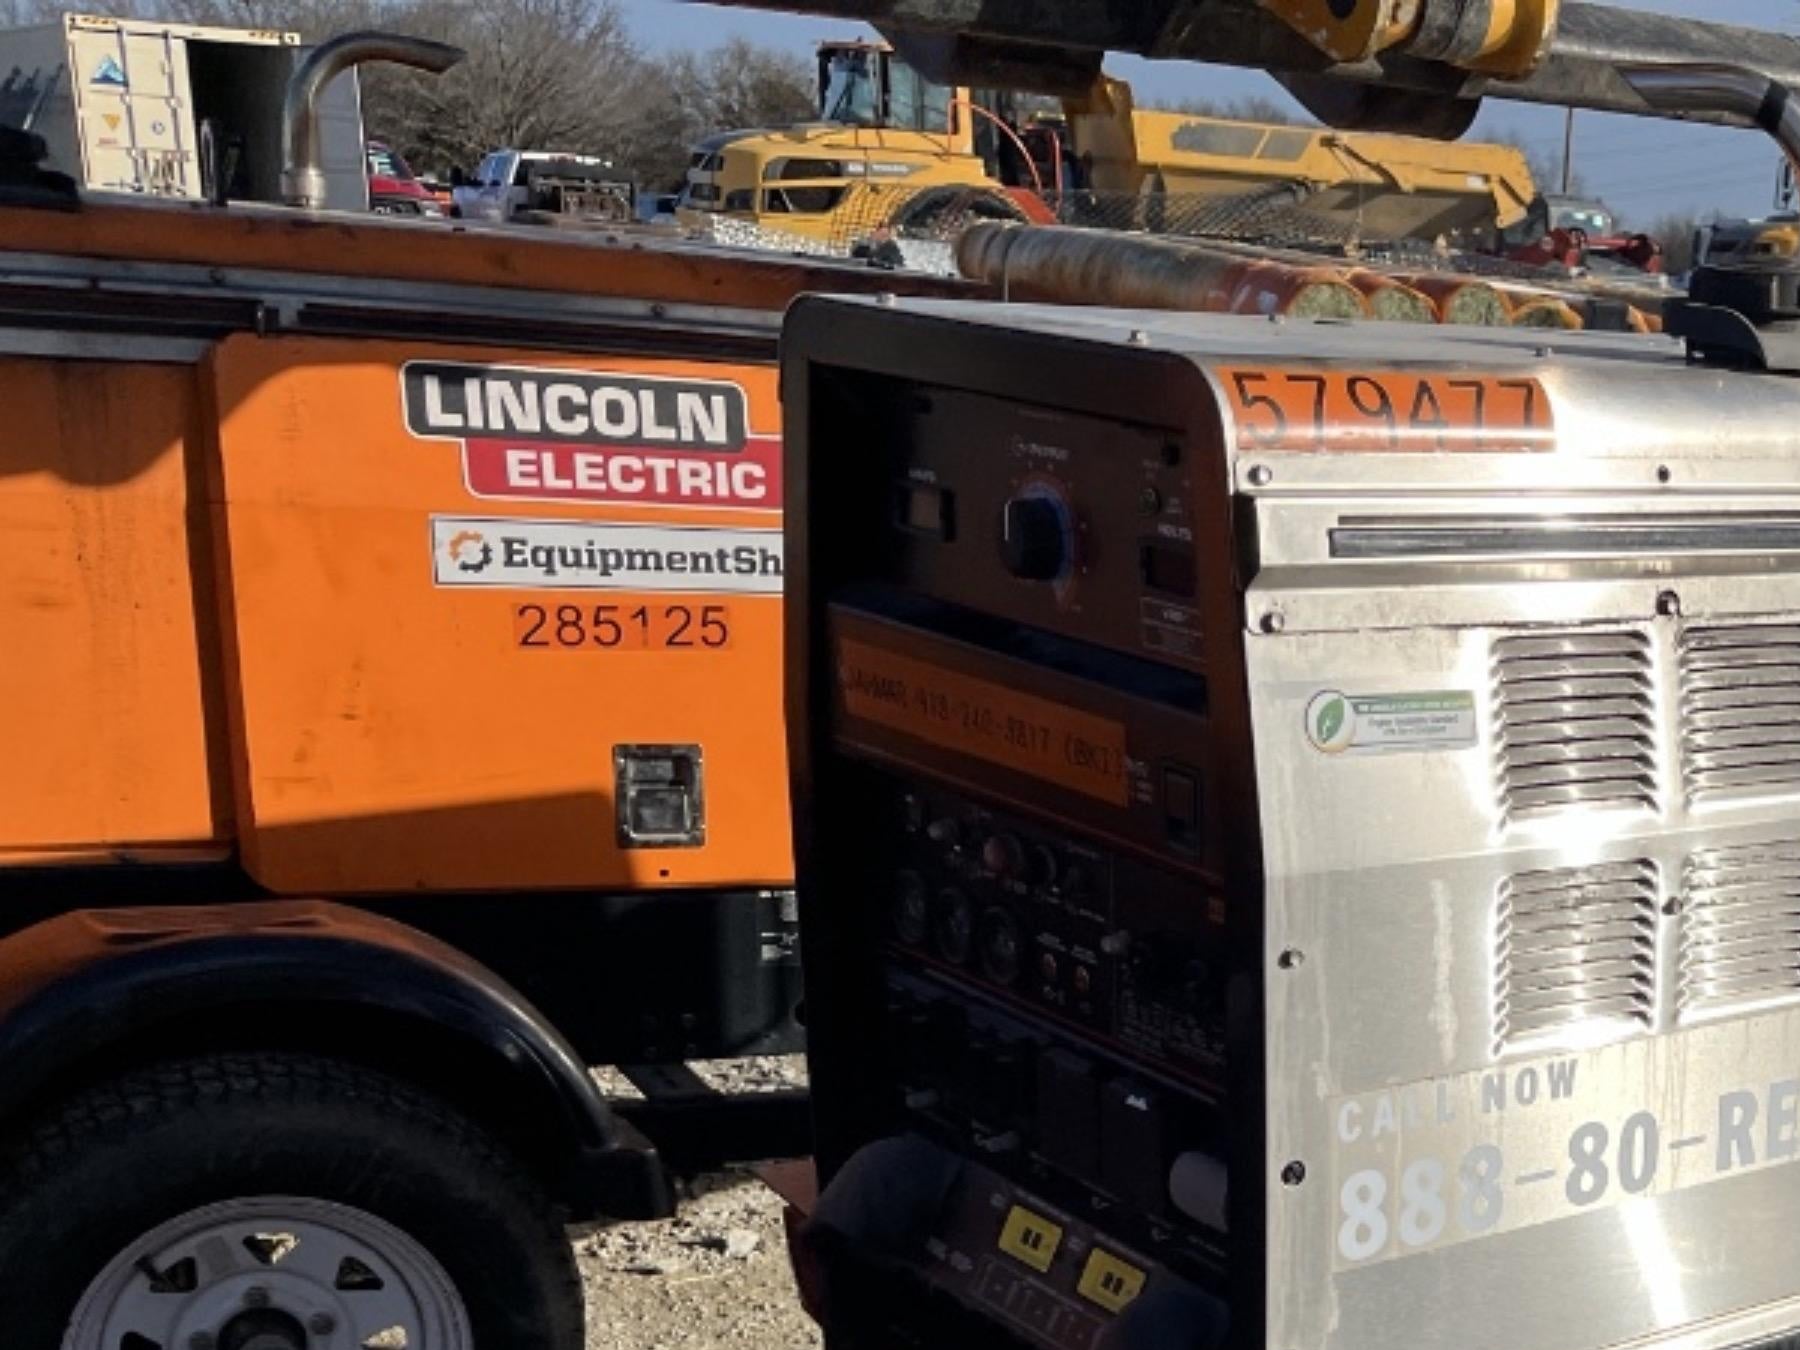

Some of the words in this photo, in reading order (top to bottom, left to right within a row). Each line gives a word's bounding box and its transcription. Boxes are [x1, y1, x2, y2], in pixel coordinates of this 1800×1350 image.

[423, 374, 728, 445] LINCOLN
[1232, 371, 1536, 449] 579477
[504, 449, 767, 500] ELECTRIC
[517, 604, 728, 648] 285125
[1337, 1084, 1456, 1143] CALL
[1481, 1059, 1578, 1113] NOW
